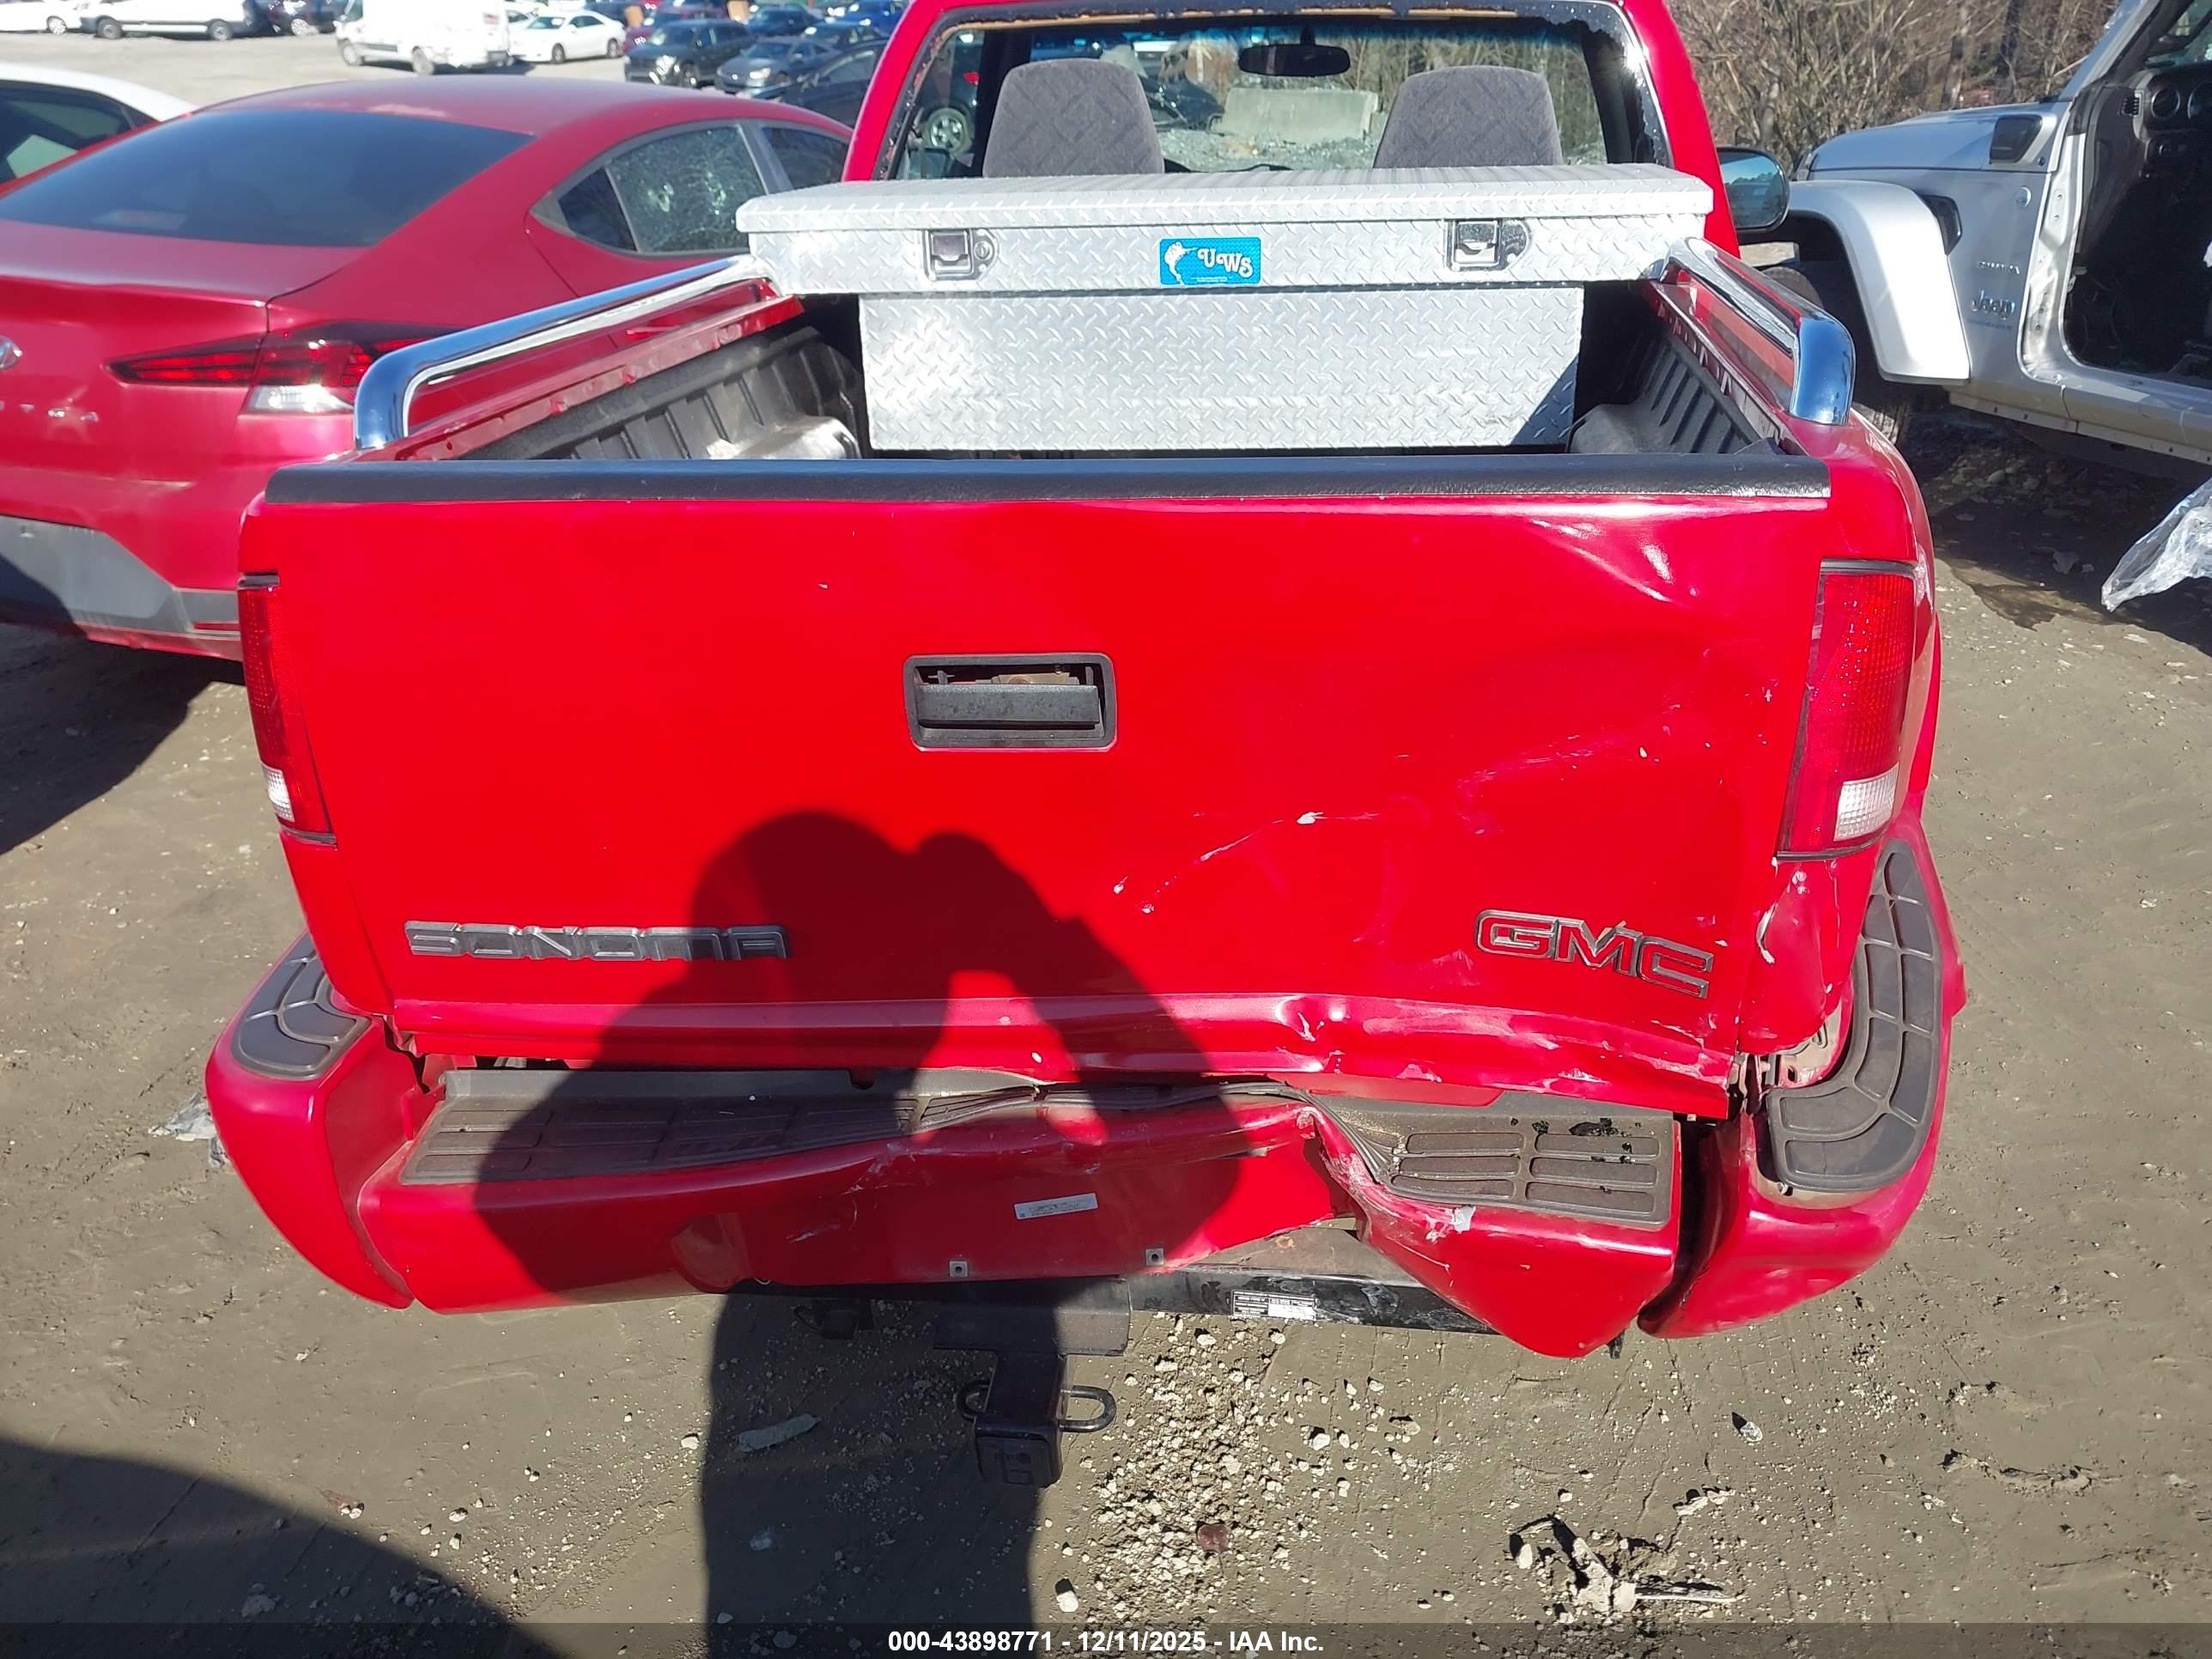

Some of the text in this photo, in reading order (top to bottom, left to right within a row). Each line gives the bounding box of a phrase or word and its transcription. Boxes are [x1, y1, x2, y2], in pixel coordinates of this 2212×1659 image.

[1197, 248, 1255, 278] UWS
[1971, 289, 2016, 320] Jeep
[404, 921, 788, 961] SONOMA
[1474, 909, 1715, 1000] GMC
